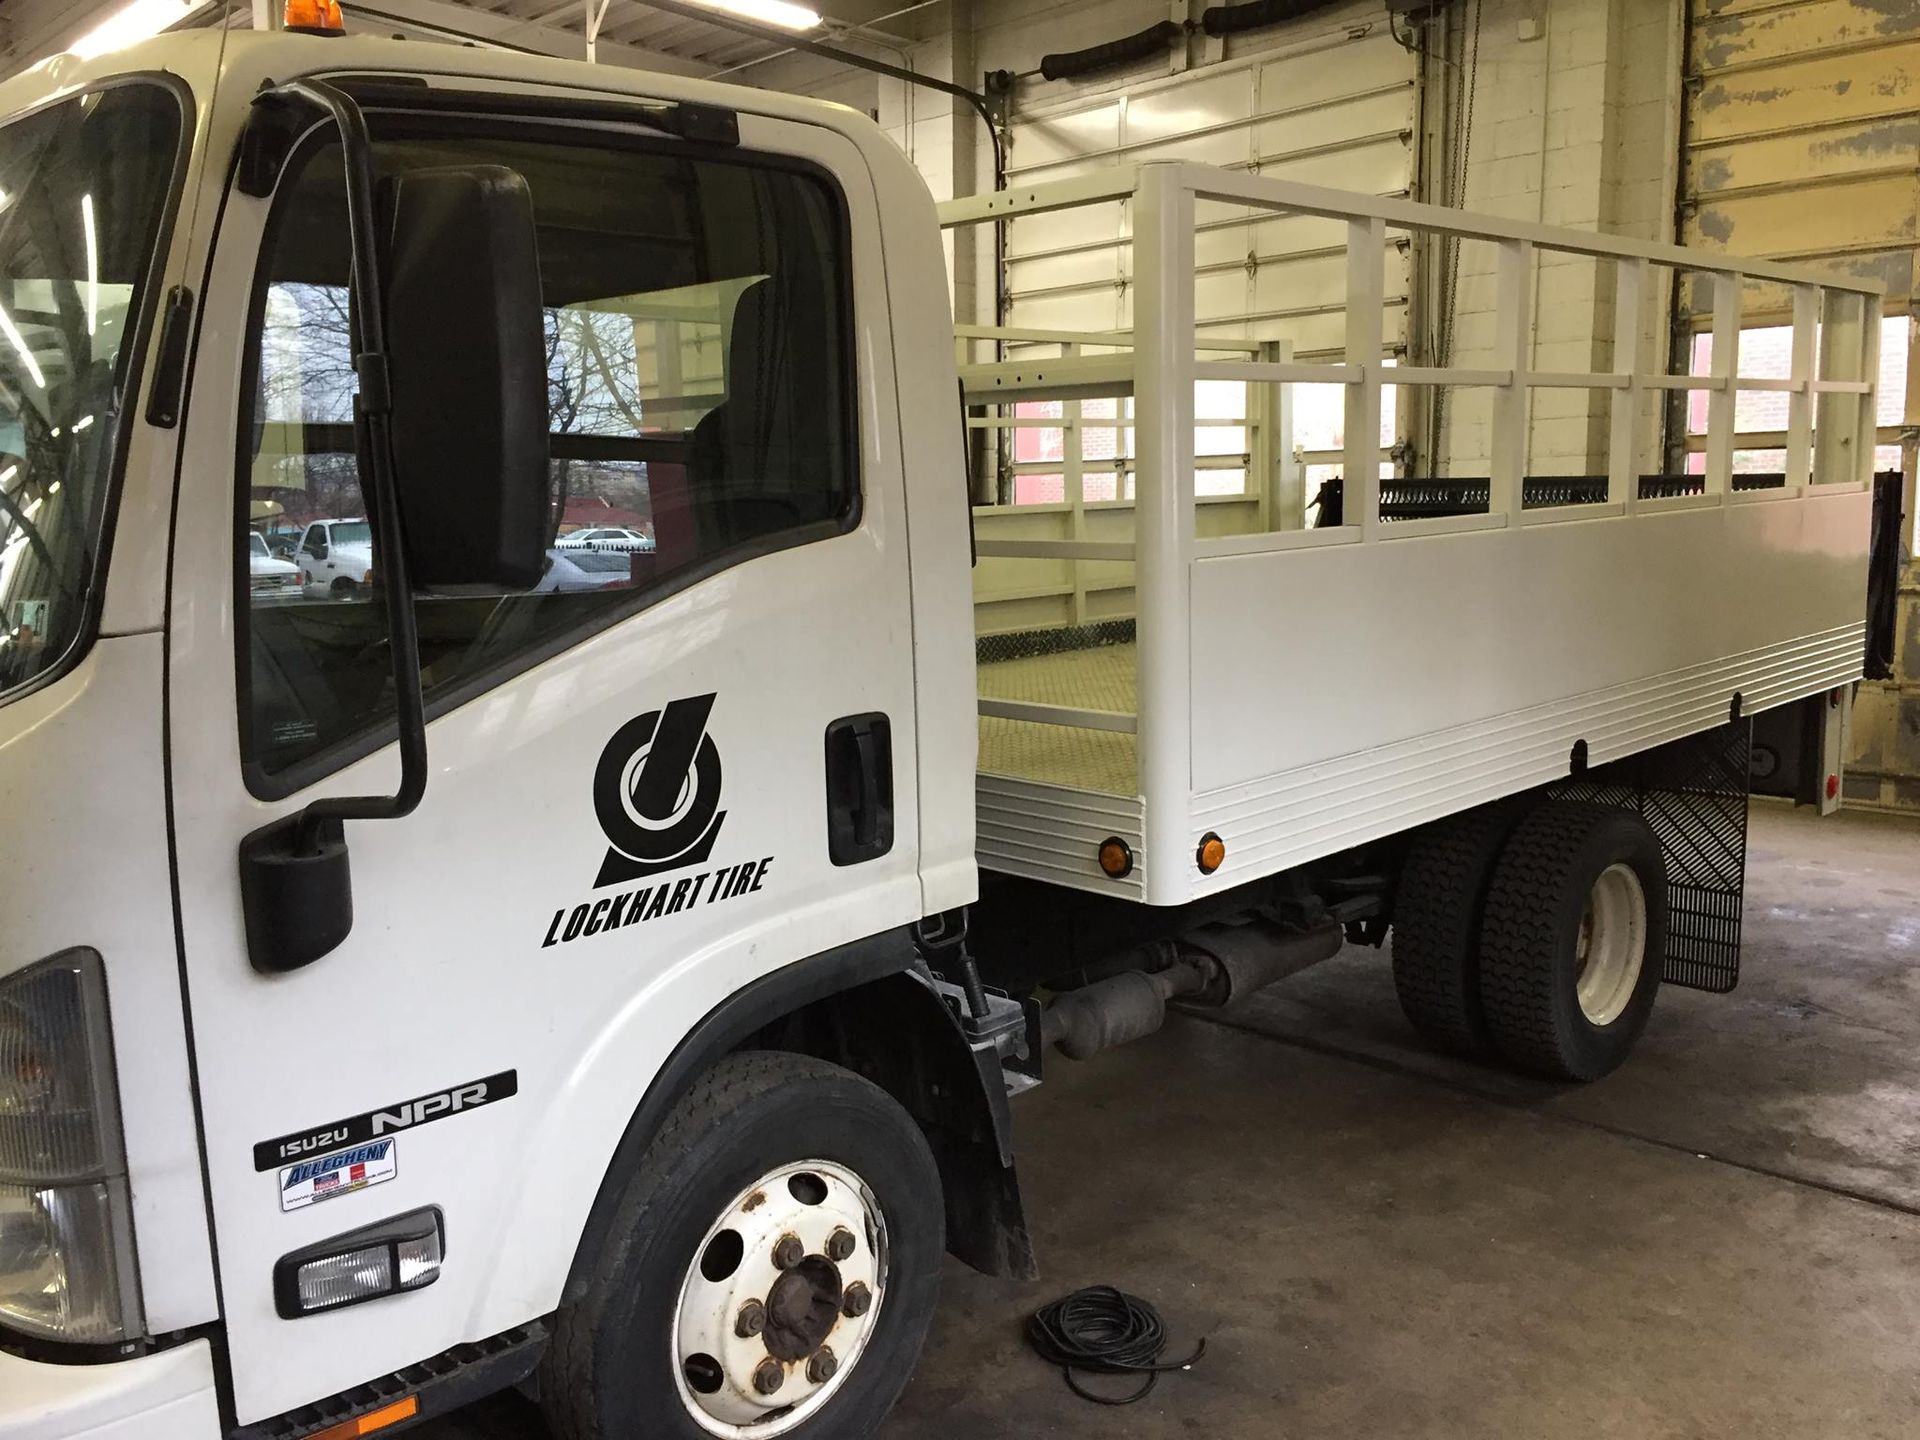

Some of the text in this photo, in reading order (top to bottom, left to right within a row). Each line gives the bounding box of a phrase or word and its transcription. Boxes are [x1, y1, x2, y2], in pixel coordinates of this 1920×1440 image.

[541, 856, 775, 949] LOCKHART TIRE
[279, 1082, 488, 1158] ISUZU NPR
[285, 1141, 391, 1188] ALLEGHENY
